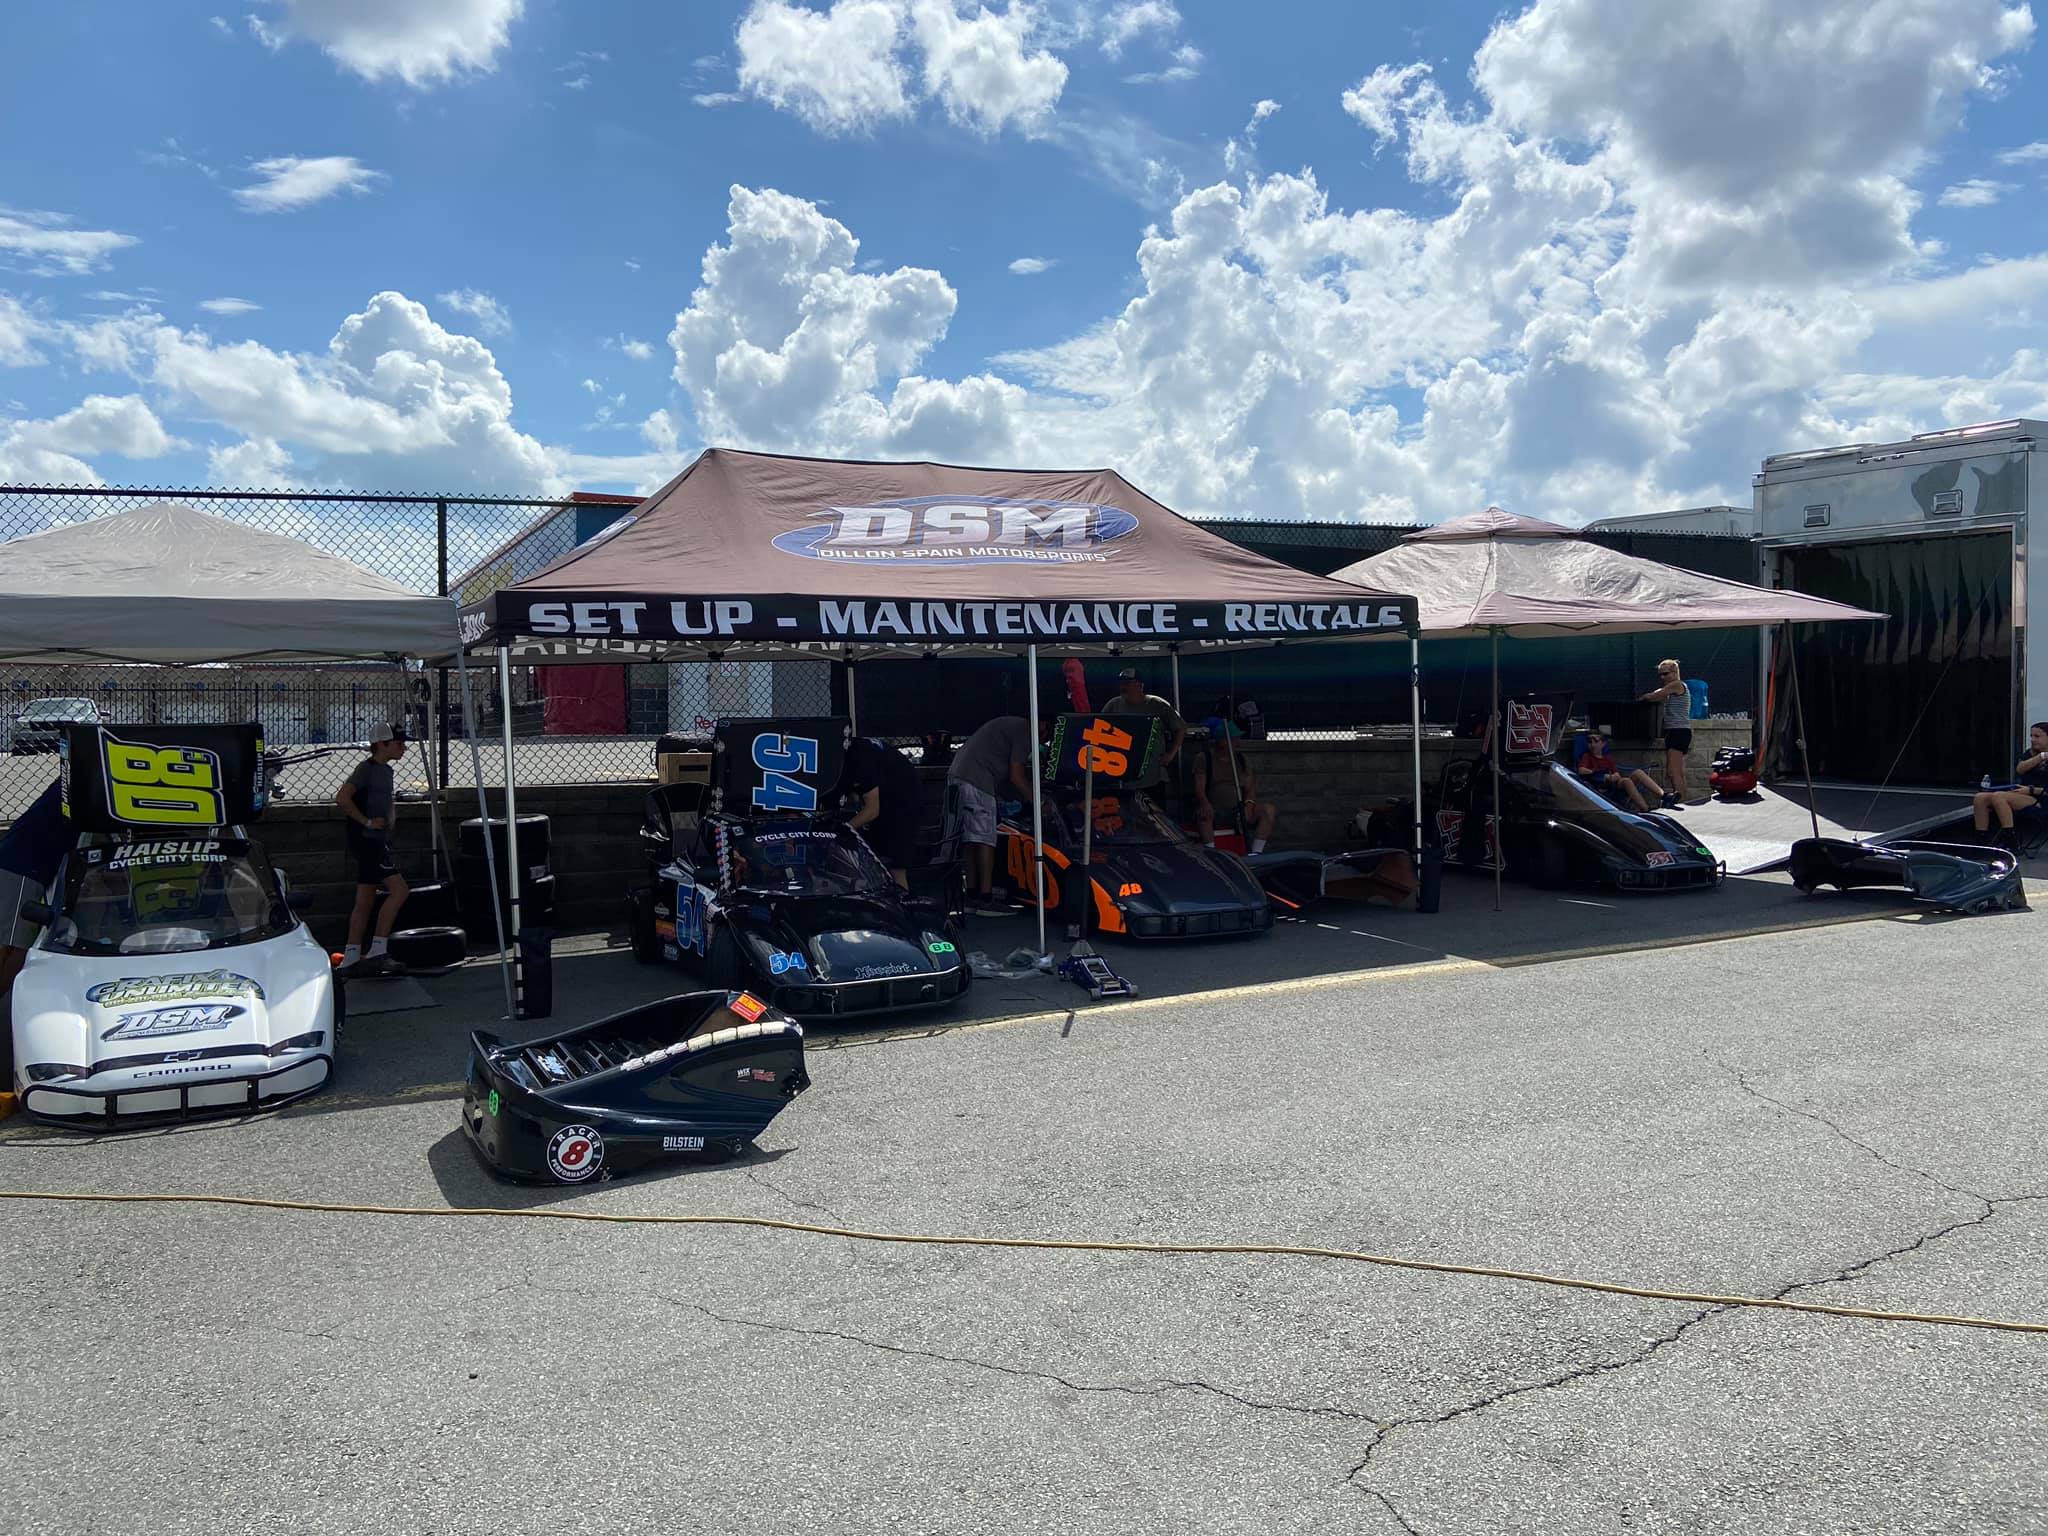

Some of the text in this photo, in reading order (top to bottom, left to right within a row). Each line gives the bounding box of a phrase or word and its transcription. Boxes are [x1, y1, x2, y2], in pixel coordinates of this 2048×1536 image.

[826, 505, 1092, 548] DSM
[819, 547, 1106, 562] DILLON SPAIN MOTORSPORTS
[528, 602, 646, 634] SET
[670, 601, 753, 635] UP
[818, 601, 1179, 635] MAINTENANCE
[1224, 603, 1404, 632] RENTALS
[1077, 718, 1133, 776] 48
[752, 733, 818, 811] 54
[755, 832, 787, 843] CYCLE
[114, 841, 220, 859] HAISLIP
[109, 854, 228, 869] CYCLE CITY CORP
[1119, 883, 1143, 896] 48
[676, 882, 704, 957] 54
[768, 952, 807, 975] 54
[118, 1006, 230, 1034] DSM
[133, 1063, 231, 1079] CAMARO
[556, 1127, 601, 1149] RACER
[663, 1136, 705, 1148] BILSTEIN
[562, 1140, 590, 1165] 8
[551, 1158, 594, 1178] PERFORMANCE
